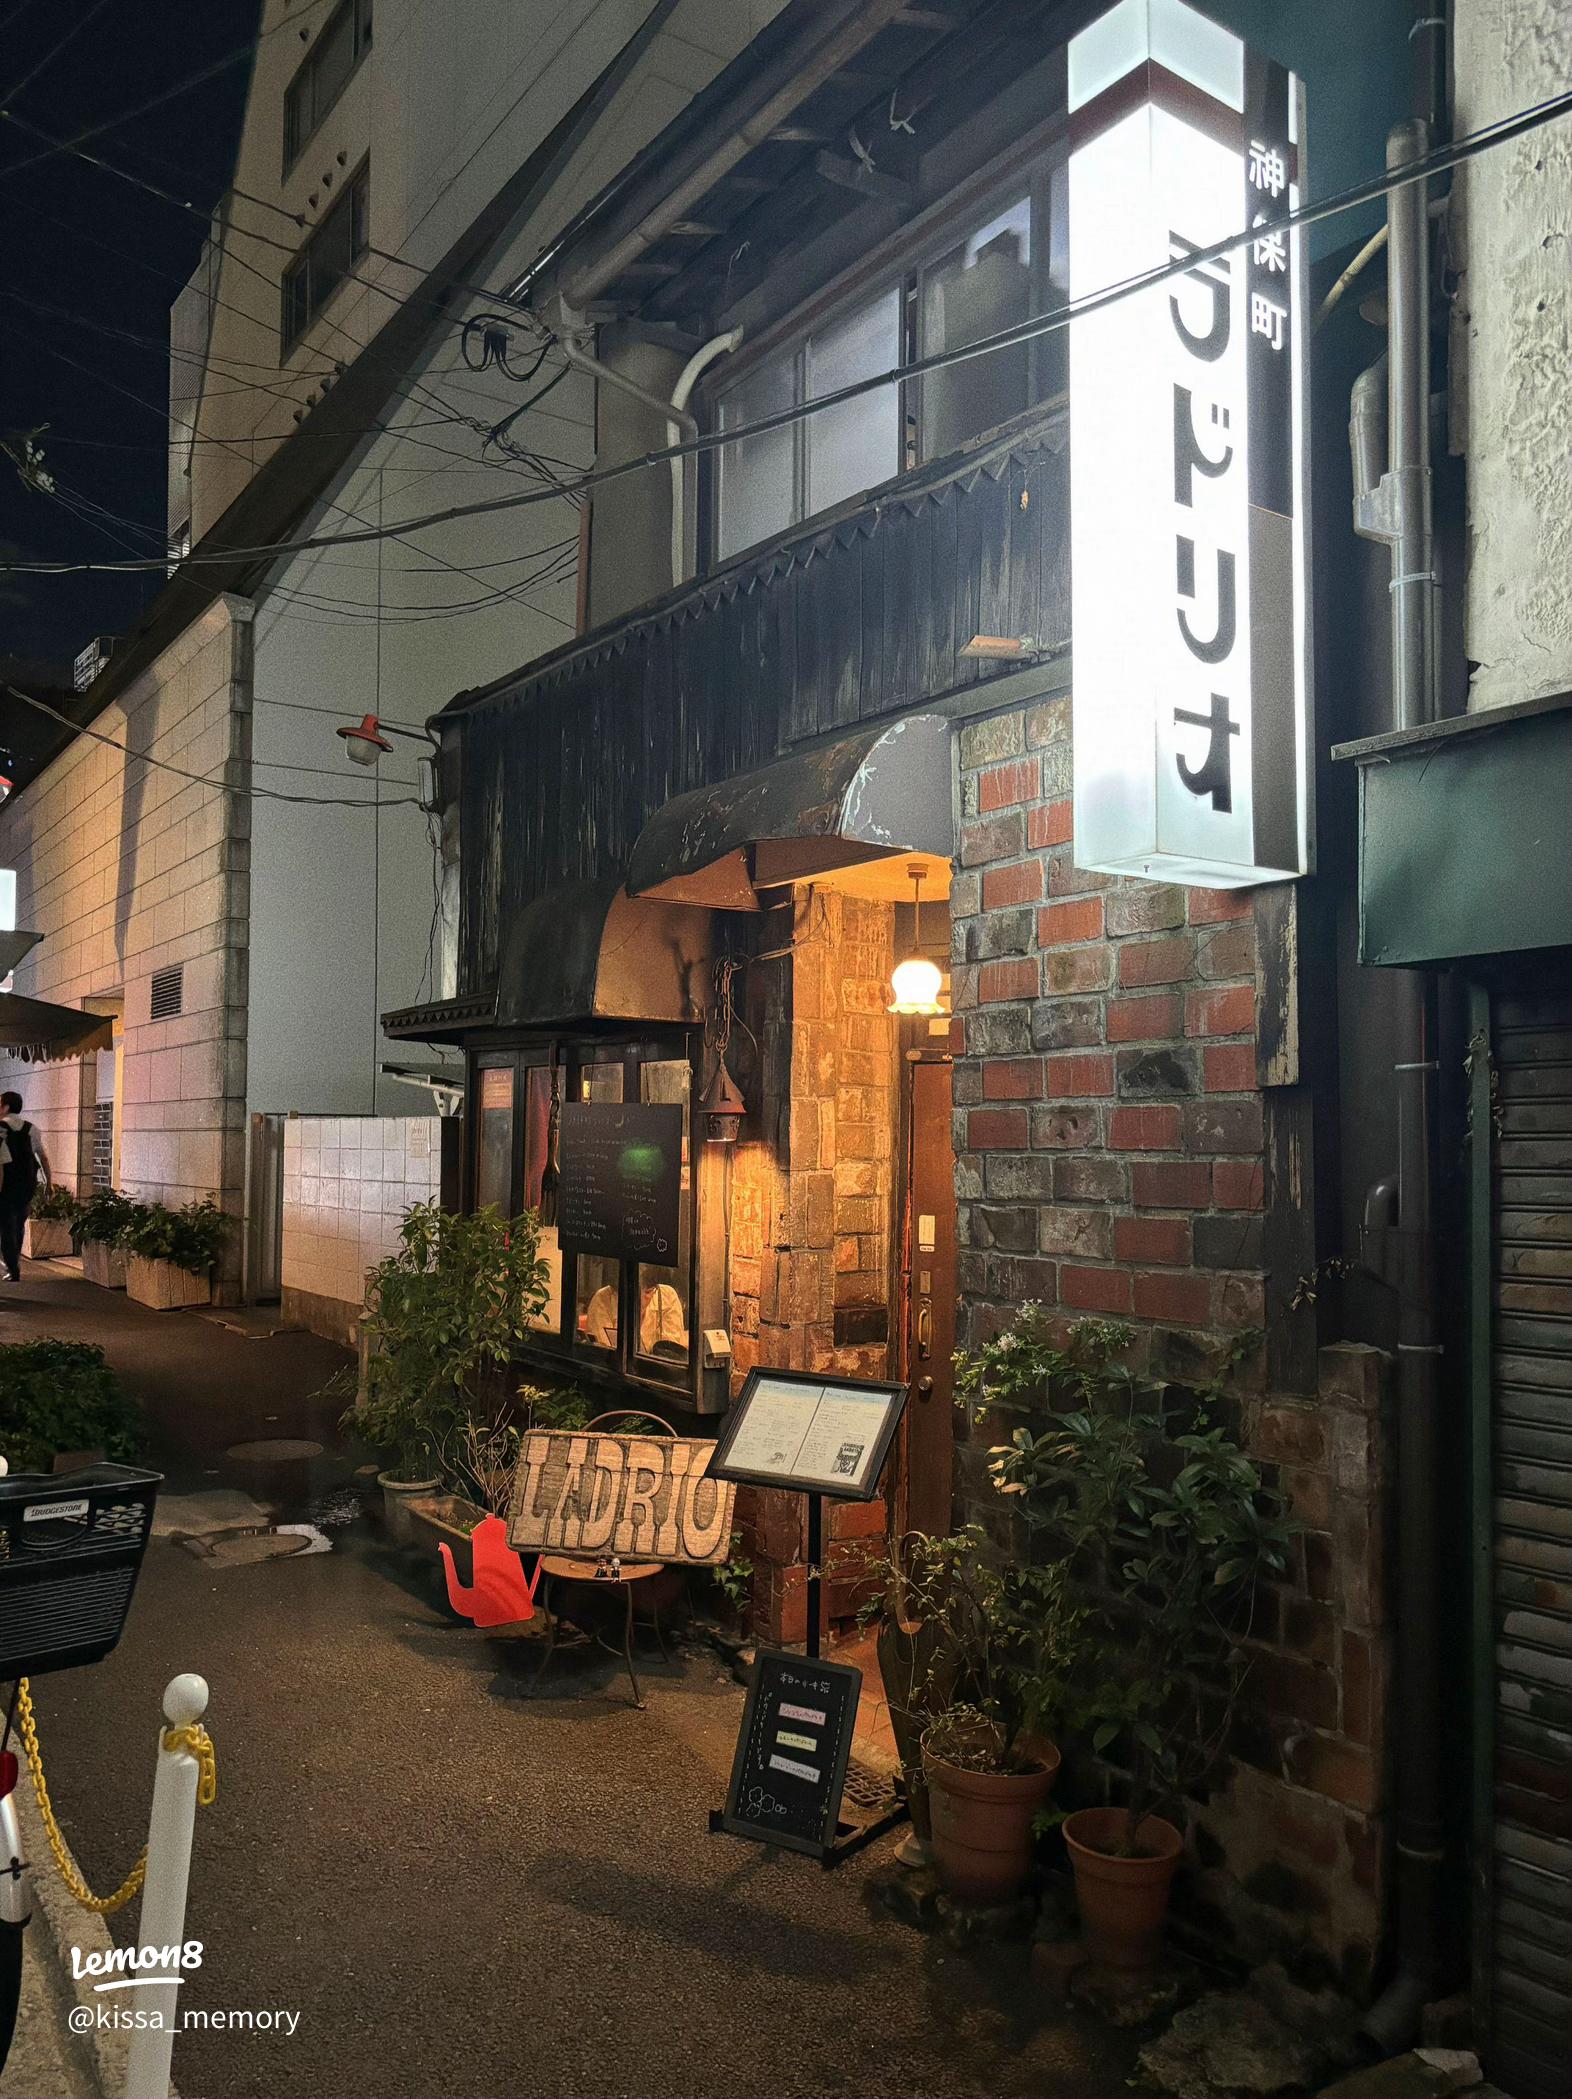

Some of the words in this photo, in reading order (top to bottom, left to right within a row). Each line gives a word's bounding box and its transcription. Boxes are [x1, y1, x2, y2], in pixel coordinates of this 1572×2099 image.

[1248, 139, 1288, 352] 神保町
[1168, 228, 1242, 815] ラドリオ
[31, 1503, 83, 1517] BRIDGESTONE
[511, 1435, 729, 1559] LADRIO
